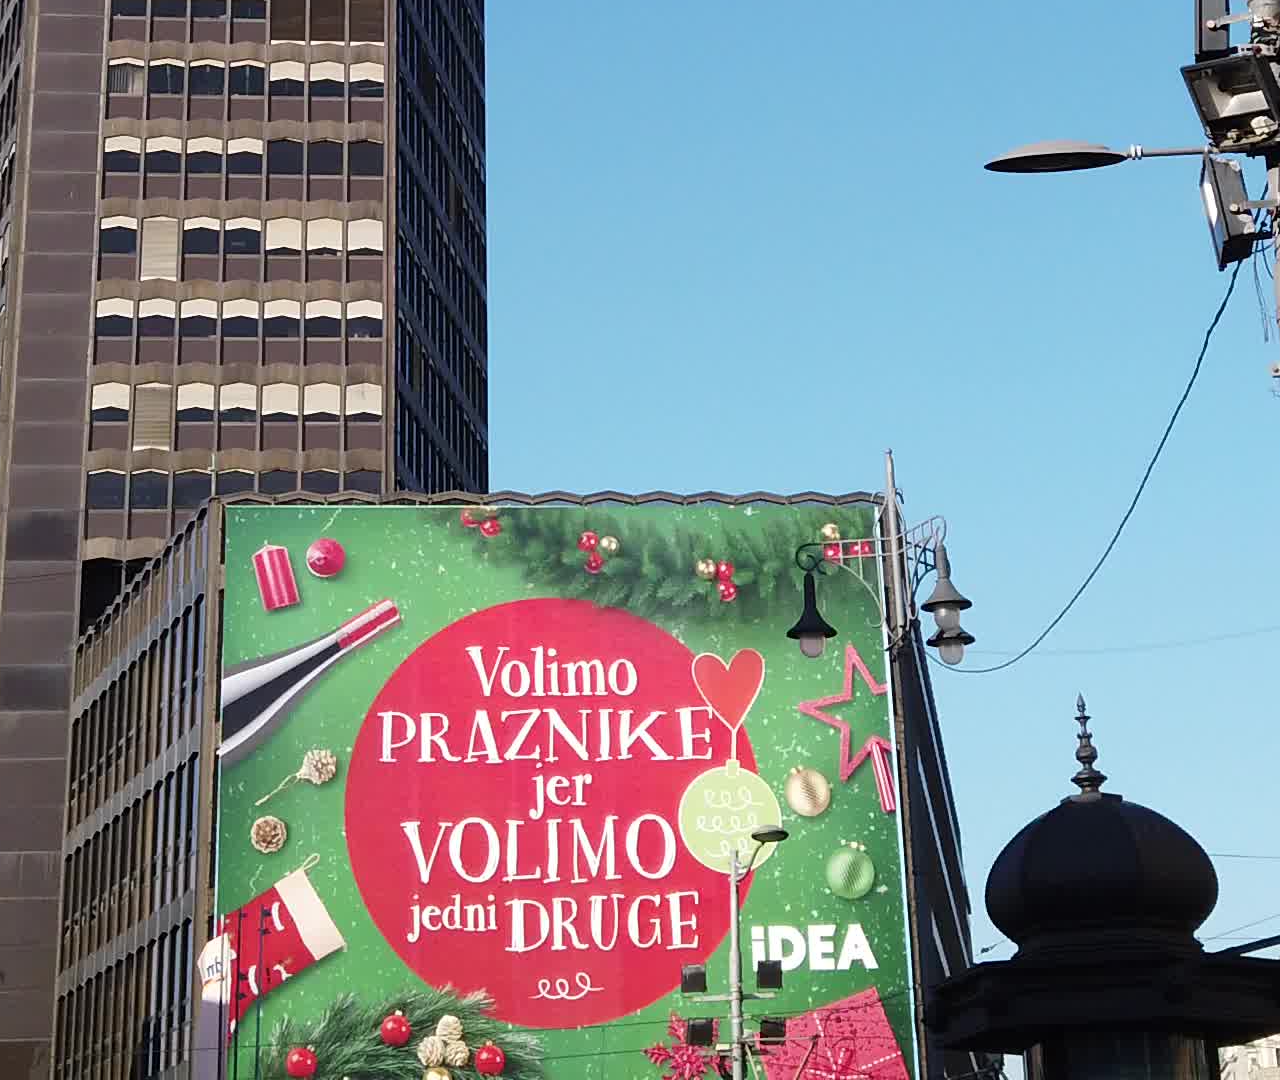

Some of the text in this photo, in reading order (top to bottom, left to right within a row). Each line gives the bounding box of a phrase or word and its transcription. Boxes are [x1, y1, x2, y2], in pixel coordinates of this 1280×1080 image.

[466, 645, 638, 698] Volimo
[378, 705, 714, 764] PRAZNIKE
[528, 761, 593, 820] jer
[401, 813, 677, 885] VOLIMO
[407, 891, 700, 953] jedni DRUGE
